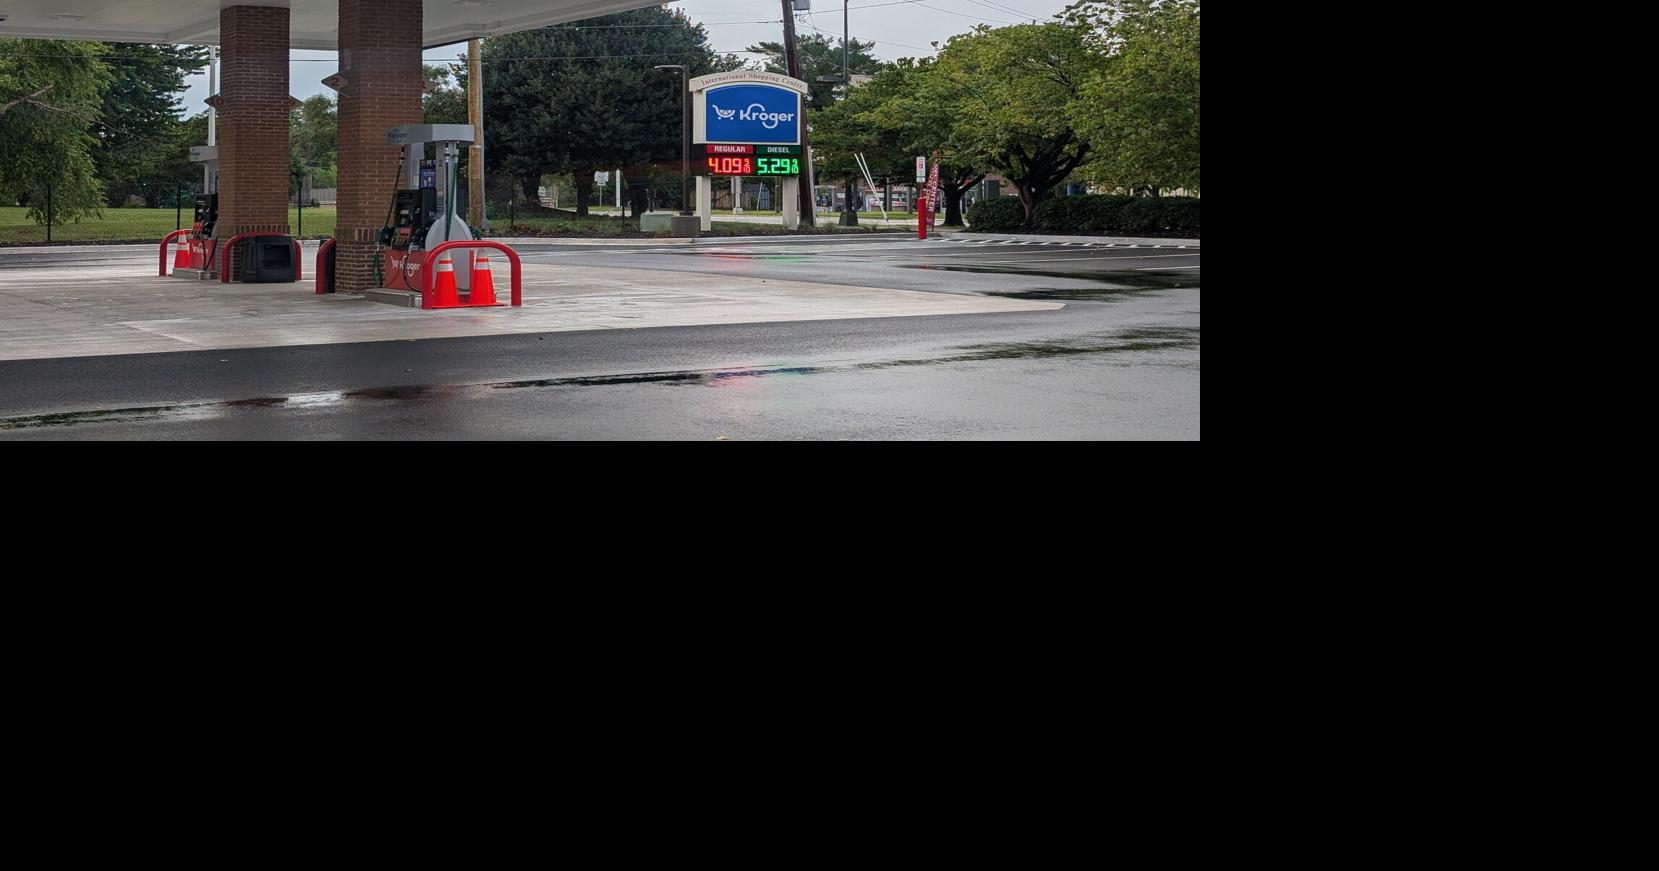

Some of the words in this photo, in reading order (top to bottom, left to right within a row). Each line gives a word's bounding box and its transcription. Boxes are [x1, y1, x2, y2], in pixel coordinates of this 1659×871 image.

[701, 72, 746, 86] International
[748, 73, 779, 82] Shopping
[782, 77, 803, 88] Center
[740, 103, 795, 129] Kroger
[708, 157, 742, 174] 4.09
[757, 158, 791, 174] 5.29
[928, 179, 937, 212] CENTER
